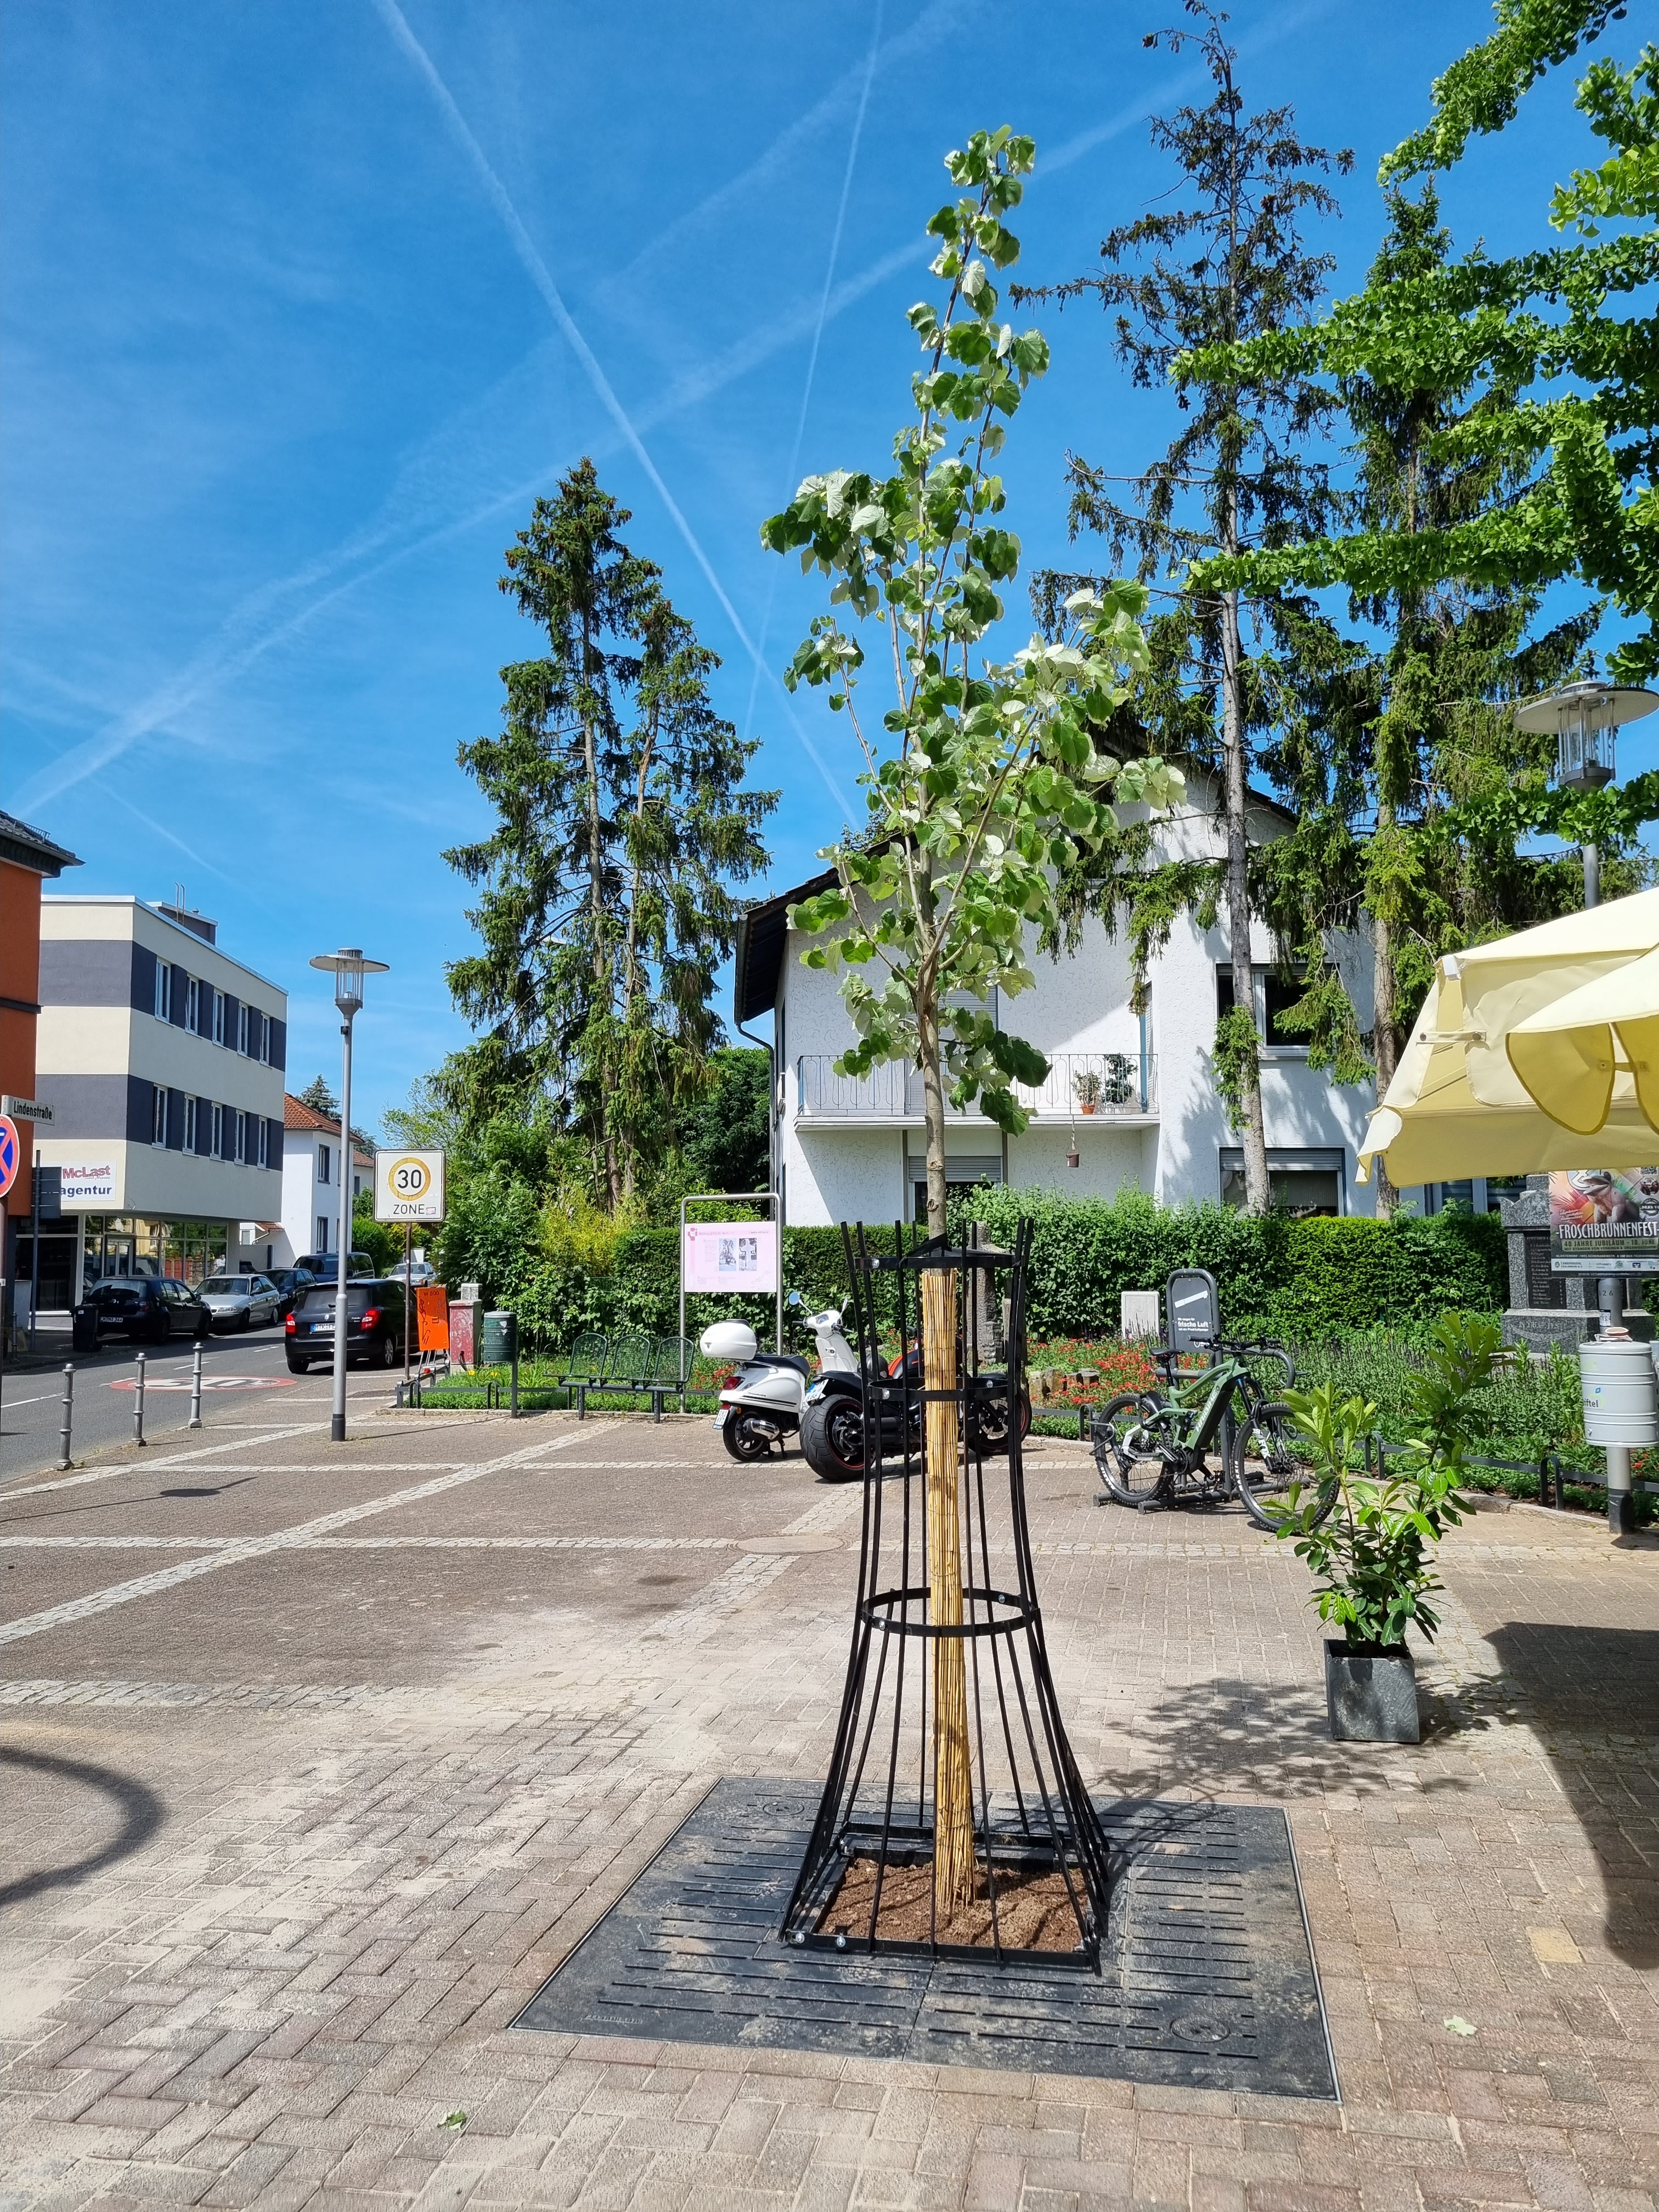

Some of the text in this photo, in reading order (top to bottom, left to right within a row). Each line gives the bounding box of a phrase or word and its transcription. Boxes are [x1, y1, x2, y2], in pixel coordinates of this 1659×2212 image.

[14, 1101, 52, 1120] Lindenstraße
[63, 1165, 110, 1180] McLast
[397, 1169, 422, 1189] 30
[393, 1204, 425, 1215] ZONE
[1583, 1398, 1599, 1408] riftel
[1234, 1460, 1244, 1491] MAXXIS
